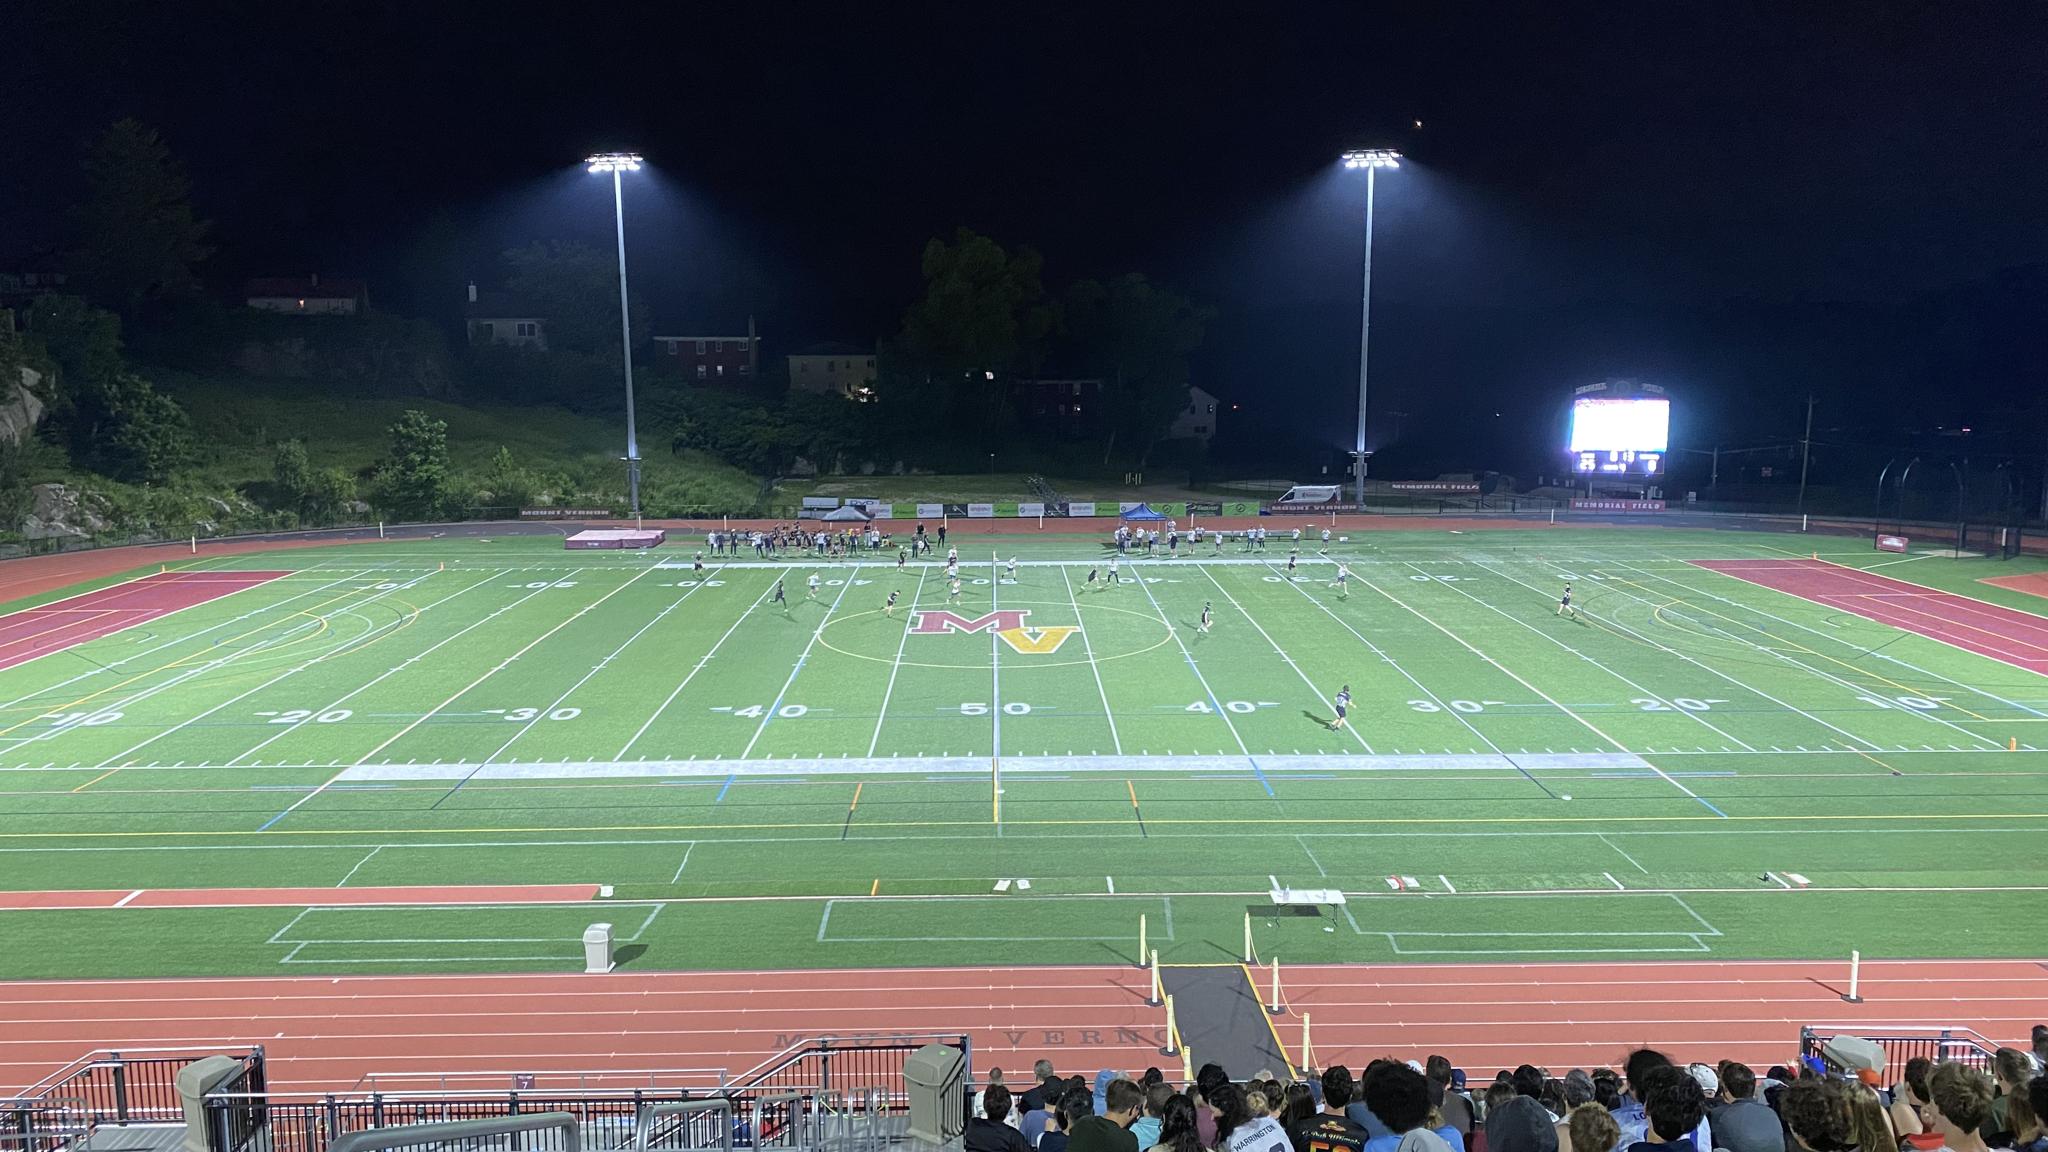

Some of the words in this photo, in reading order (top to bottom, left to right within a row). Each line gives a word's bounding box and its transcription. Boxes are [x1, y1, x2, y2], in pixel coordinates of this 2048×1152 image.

[908, 610, 1082, 654] MV
[959, 702, 1032, 715] 50
[1184, 701, 1256, 714] 40
[1406, 700, 1484, 713] 30
[1630, 698, 1711, 711] 20
[1856, 696, 1940, 709] 10
[267, 709, 353, 723] 20
[503, 707, 582, 720] 30
[734, 704, 808, 718] 40
[50, 712, 125, 726] 10
[522, 1081, 528, 1089] 7
[1233, 1124, 1276, 1152] WARRINGTON
